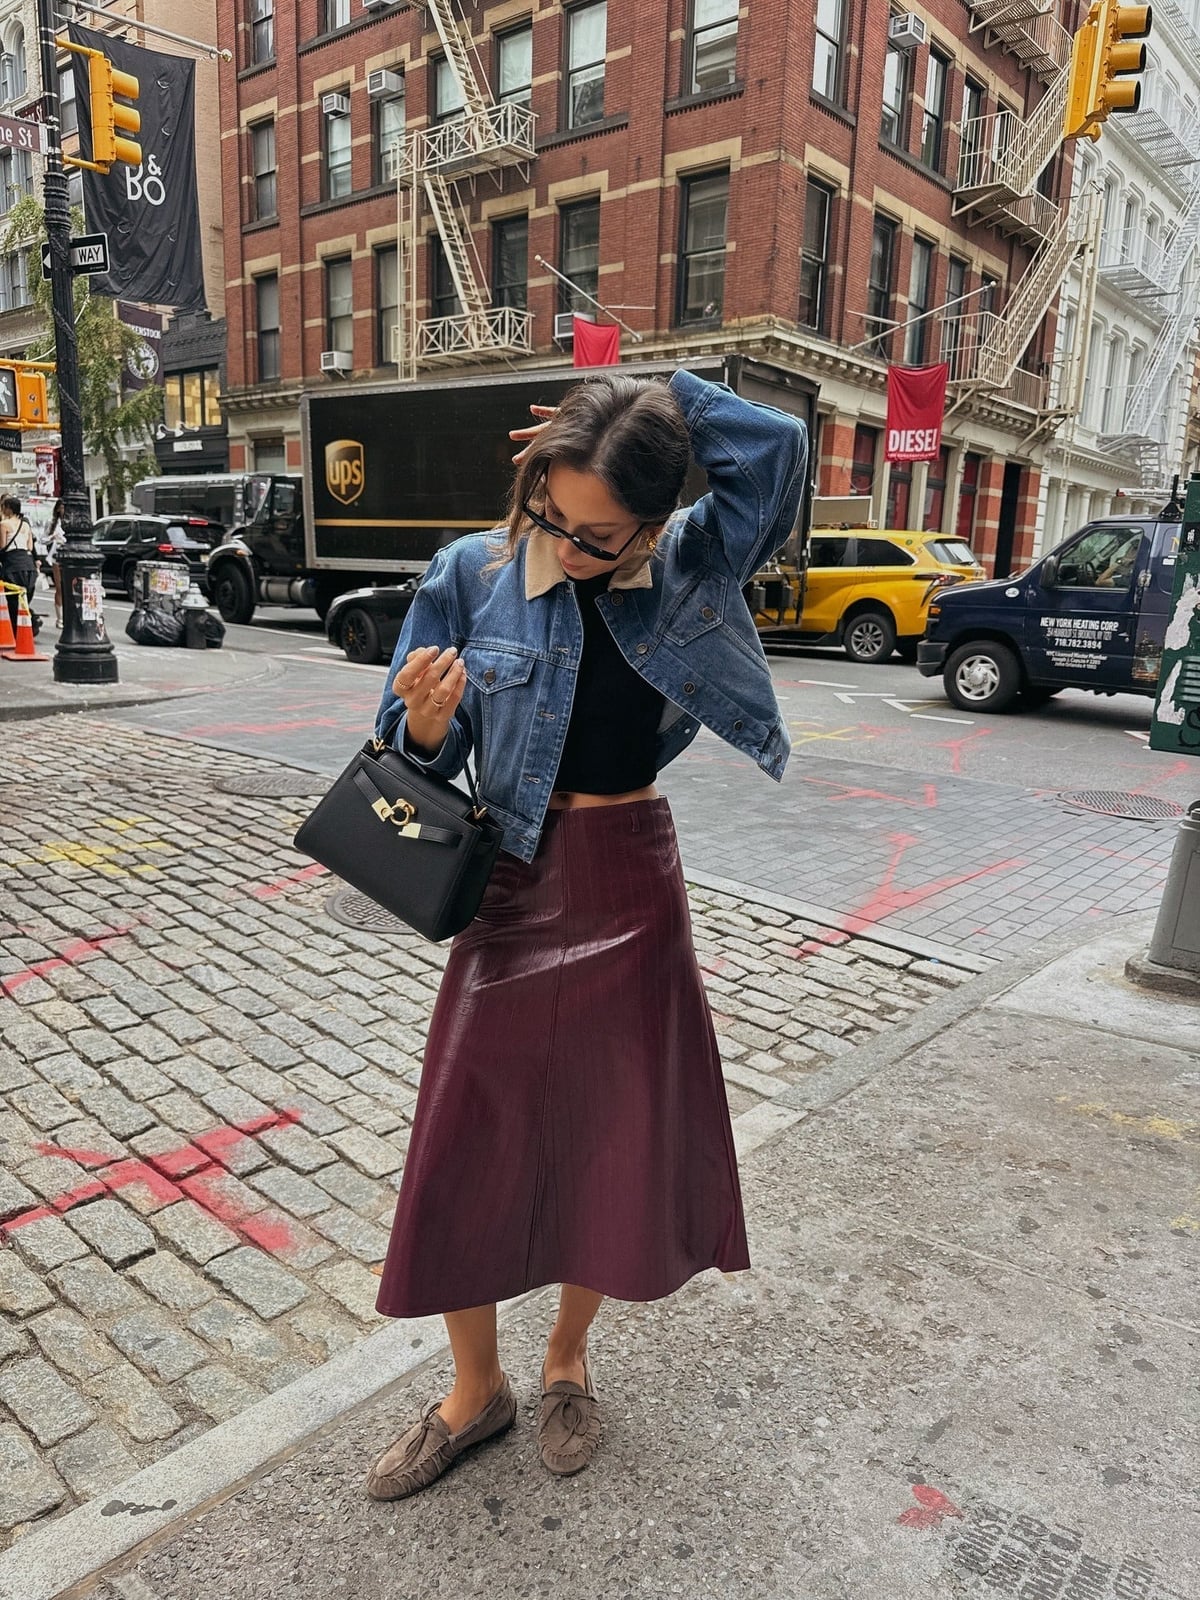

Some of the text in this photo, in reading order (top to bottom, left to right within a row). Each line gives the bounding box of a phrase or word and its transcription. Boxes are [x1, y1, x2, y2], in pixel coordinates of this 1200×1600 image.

[18, 127, 33, 148] St
[78, 246, 101, 264] WAY
[888, 428, 937, 452] DIESEL
[329, 460, 361, 494] ups
[1040, 617, 1055, 627] NEW
[1056, 618, 1072, 628] YORK
[1073, 619, 1100, 629] HEATING
